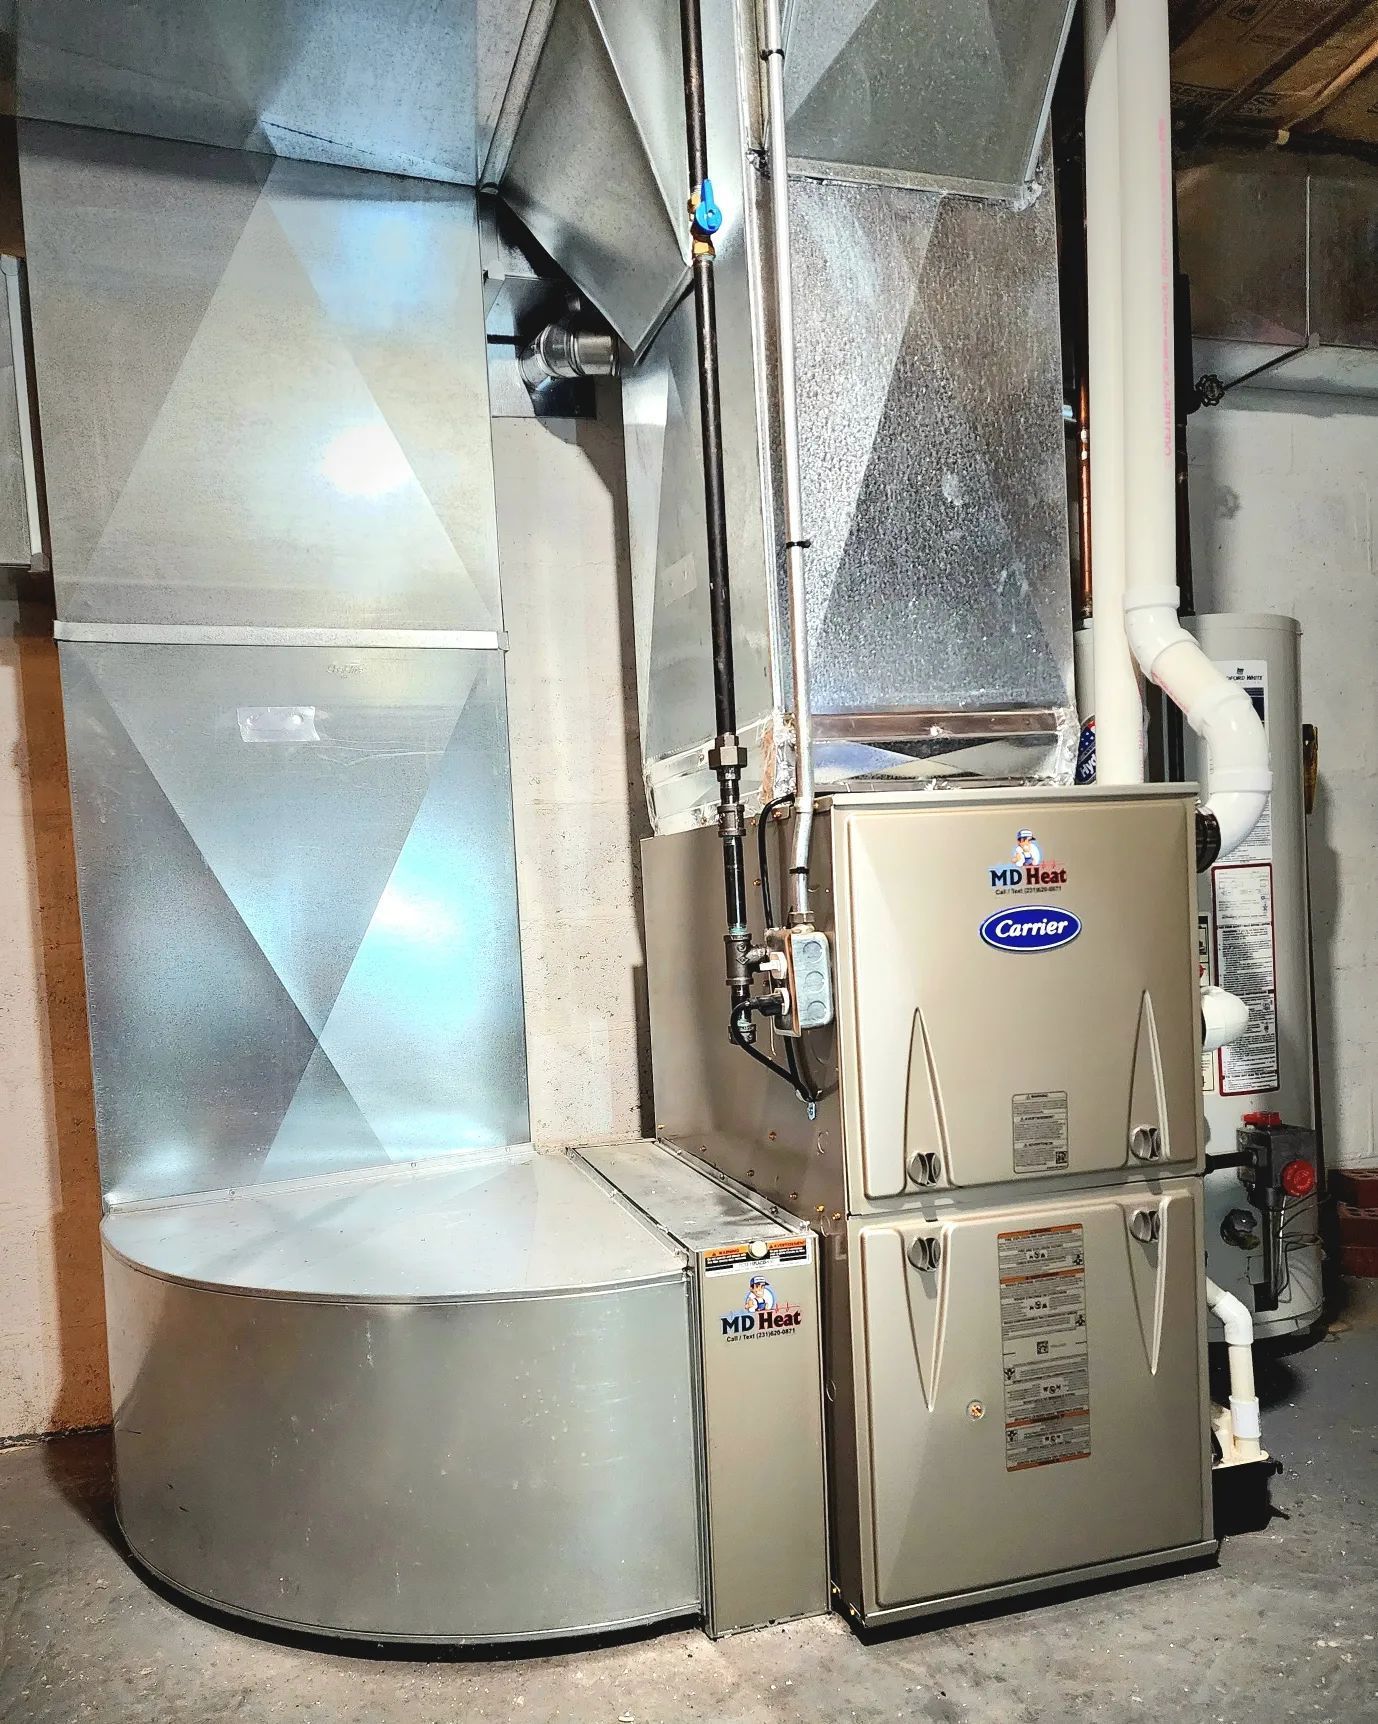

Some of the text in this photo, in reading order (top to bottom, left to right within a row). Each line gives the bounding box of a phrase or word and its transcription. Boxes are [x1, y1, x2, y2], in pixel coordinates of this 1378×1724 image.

[1080, 753, 1096, 778] Hyd
[990, 867, 1067, 886] MD Heat
[995, 918, 1068, 938] Carrier
[721, 1310, 802, 1334] MD Heat
